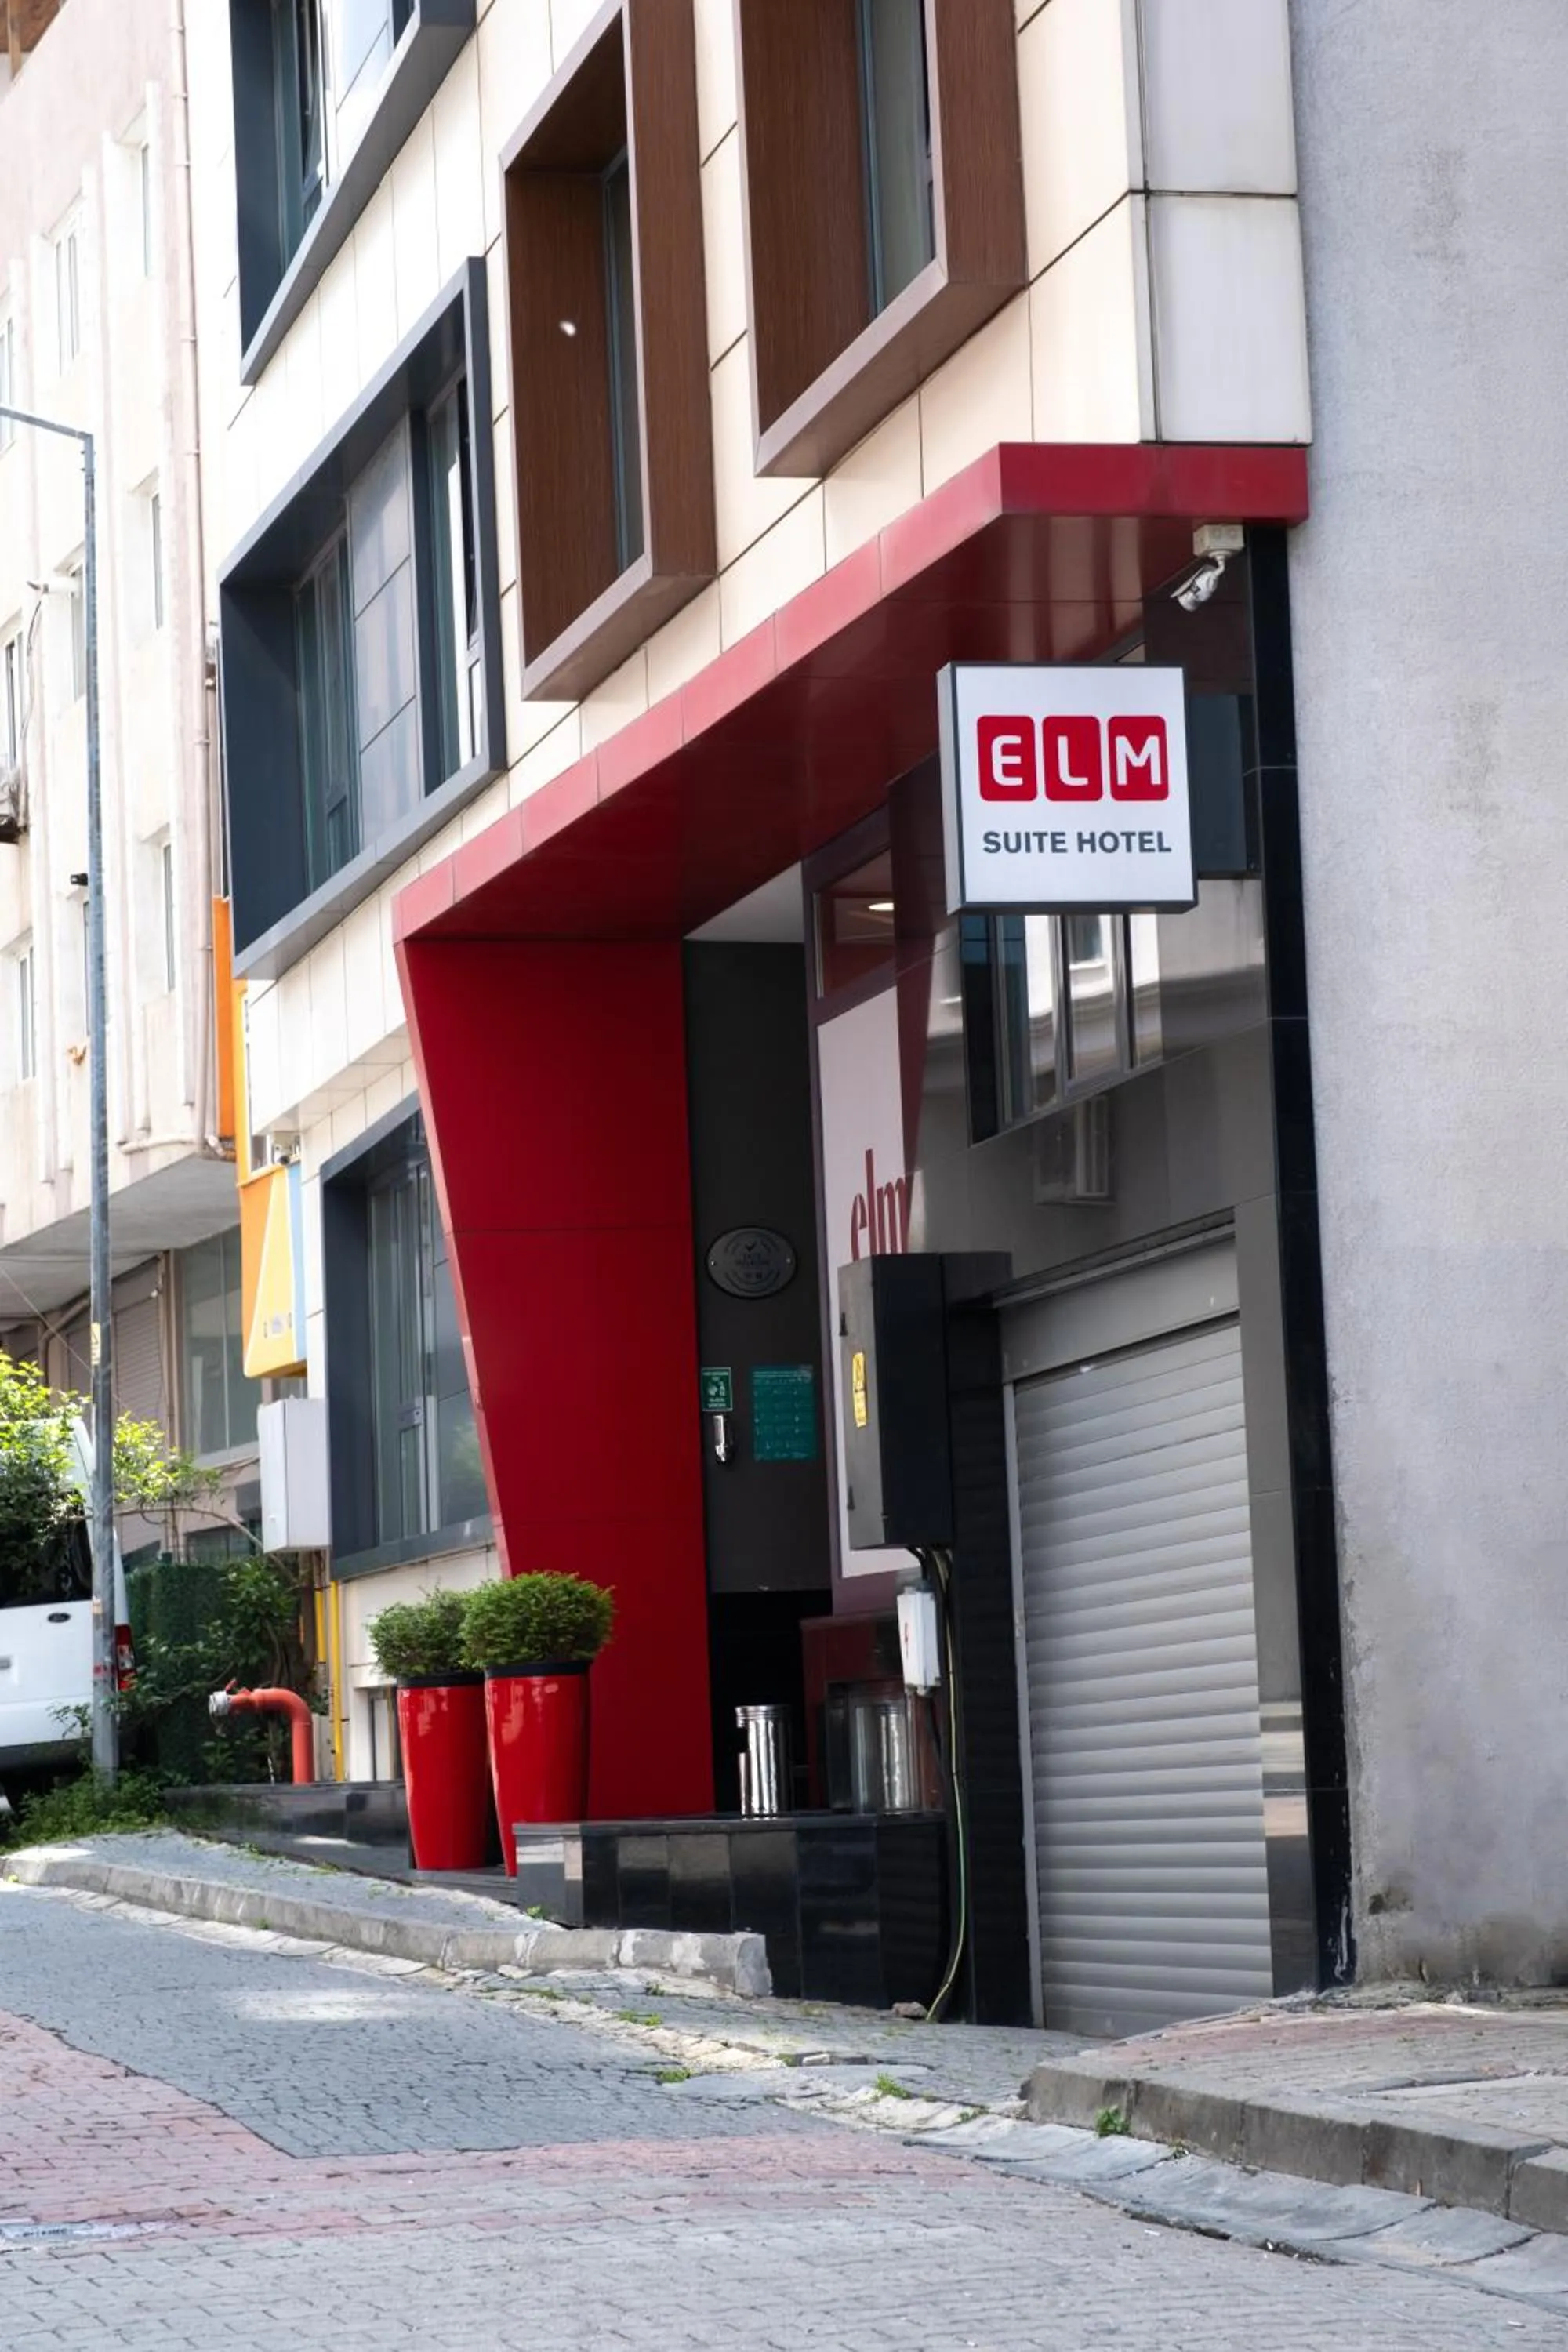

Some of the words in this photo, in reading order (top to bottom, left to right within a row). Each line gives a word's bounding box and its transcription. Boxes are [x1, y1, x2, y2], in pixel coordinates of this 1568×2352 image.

[991, 735, 1162, 786] ELM
[982, 831, 1068, 854] SUITE
[1076, 831, 1172, 853] HOTEL
